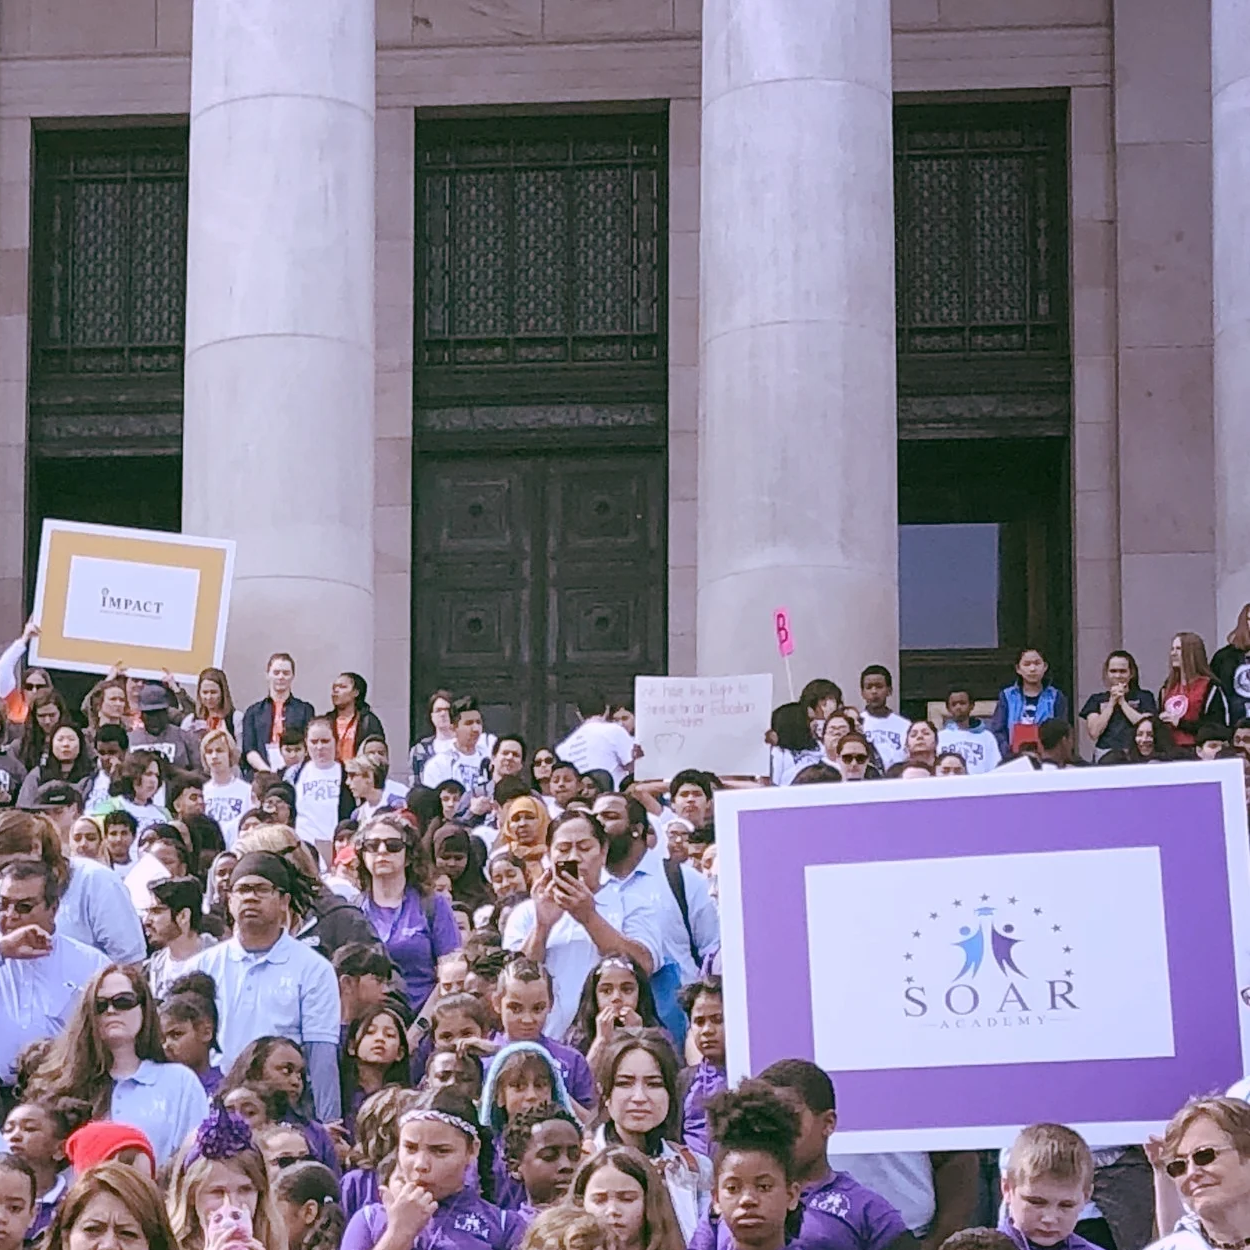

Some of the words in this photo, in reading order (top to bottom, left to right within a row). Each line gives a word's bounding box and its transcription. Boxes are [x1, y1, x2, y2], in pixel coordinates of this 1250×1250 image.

[101, 591, 164, 614] IMPACT
[777, 613, 788, 645] B
[903, 980, 1080, 1017] SOAR
[940, 1014, 1046, 1029] ACADEMY
